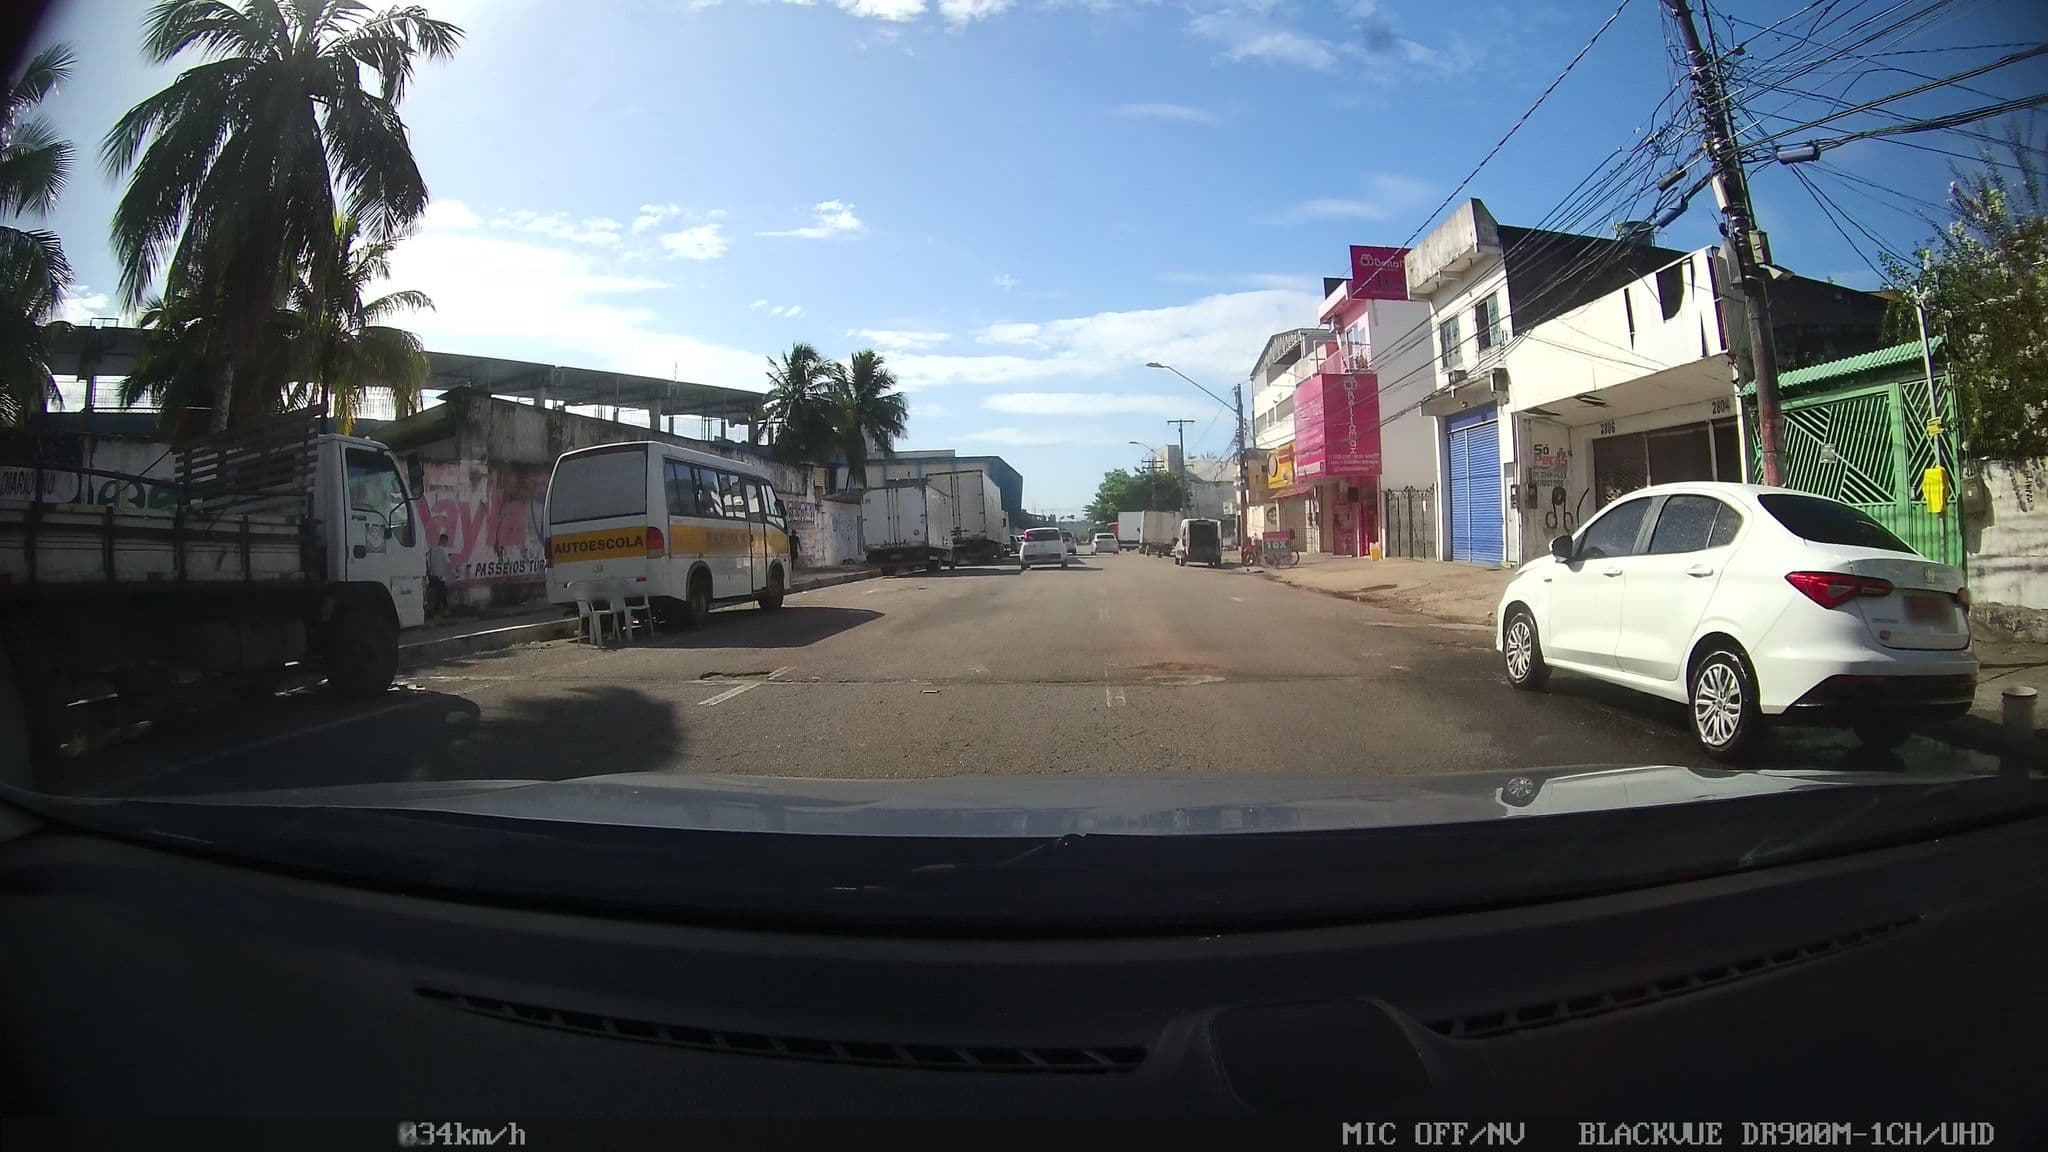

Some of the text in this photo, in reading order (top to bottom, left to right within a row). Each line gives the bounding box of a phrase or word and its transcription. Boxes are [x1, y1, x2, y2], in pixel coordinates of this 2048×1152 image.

[1711, 399, 1730, 415] 2804
[554, 535, 643, 554] AUTOESCOLA
[475, 560, 526, 577] PASSEIOS
